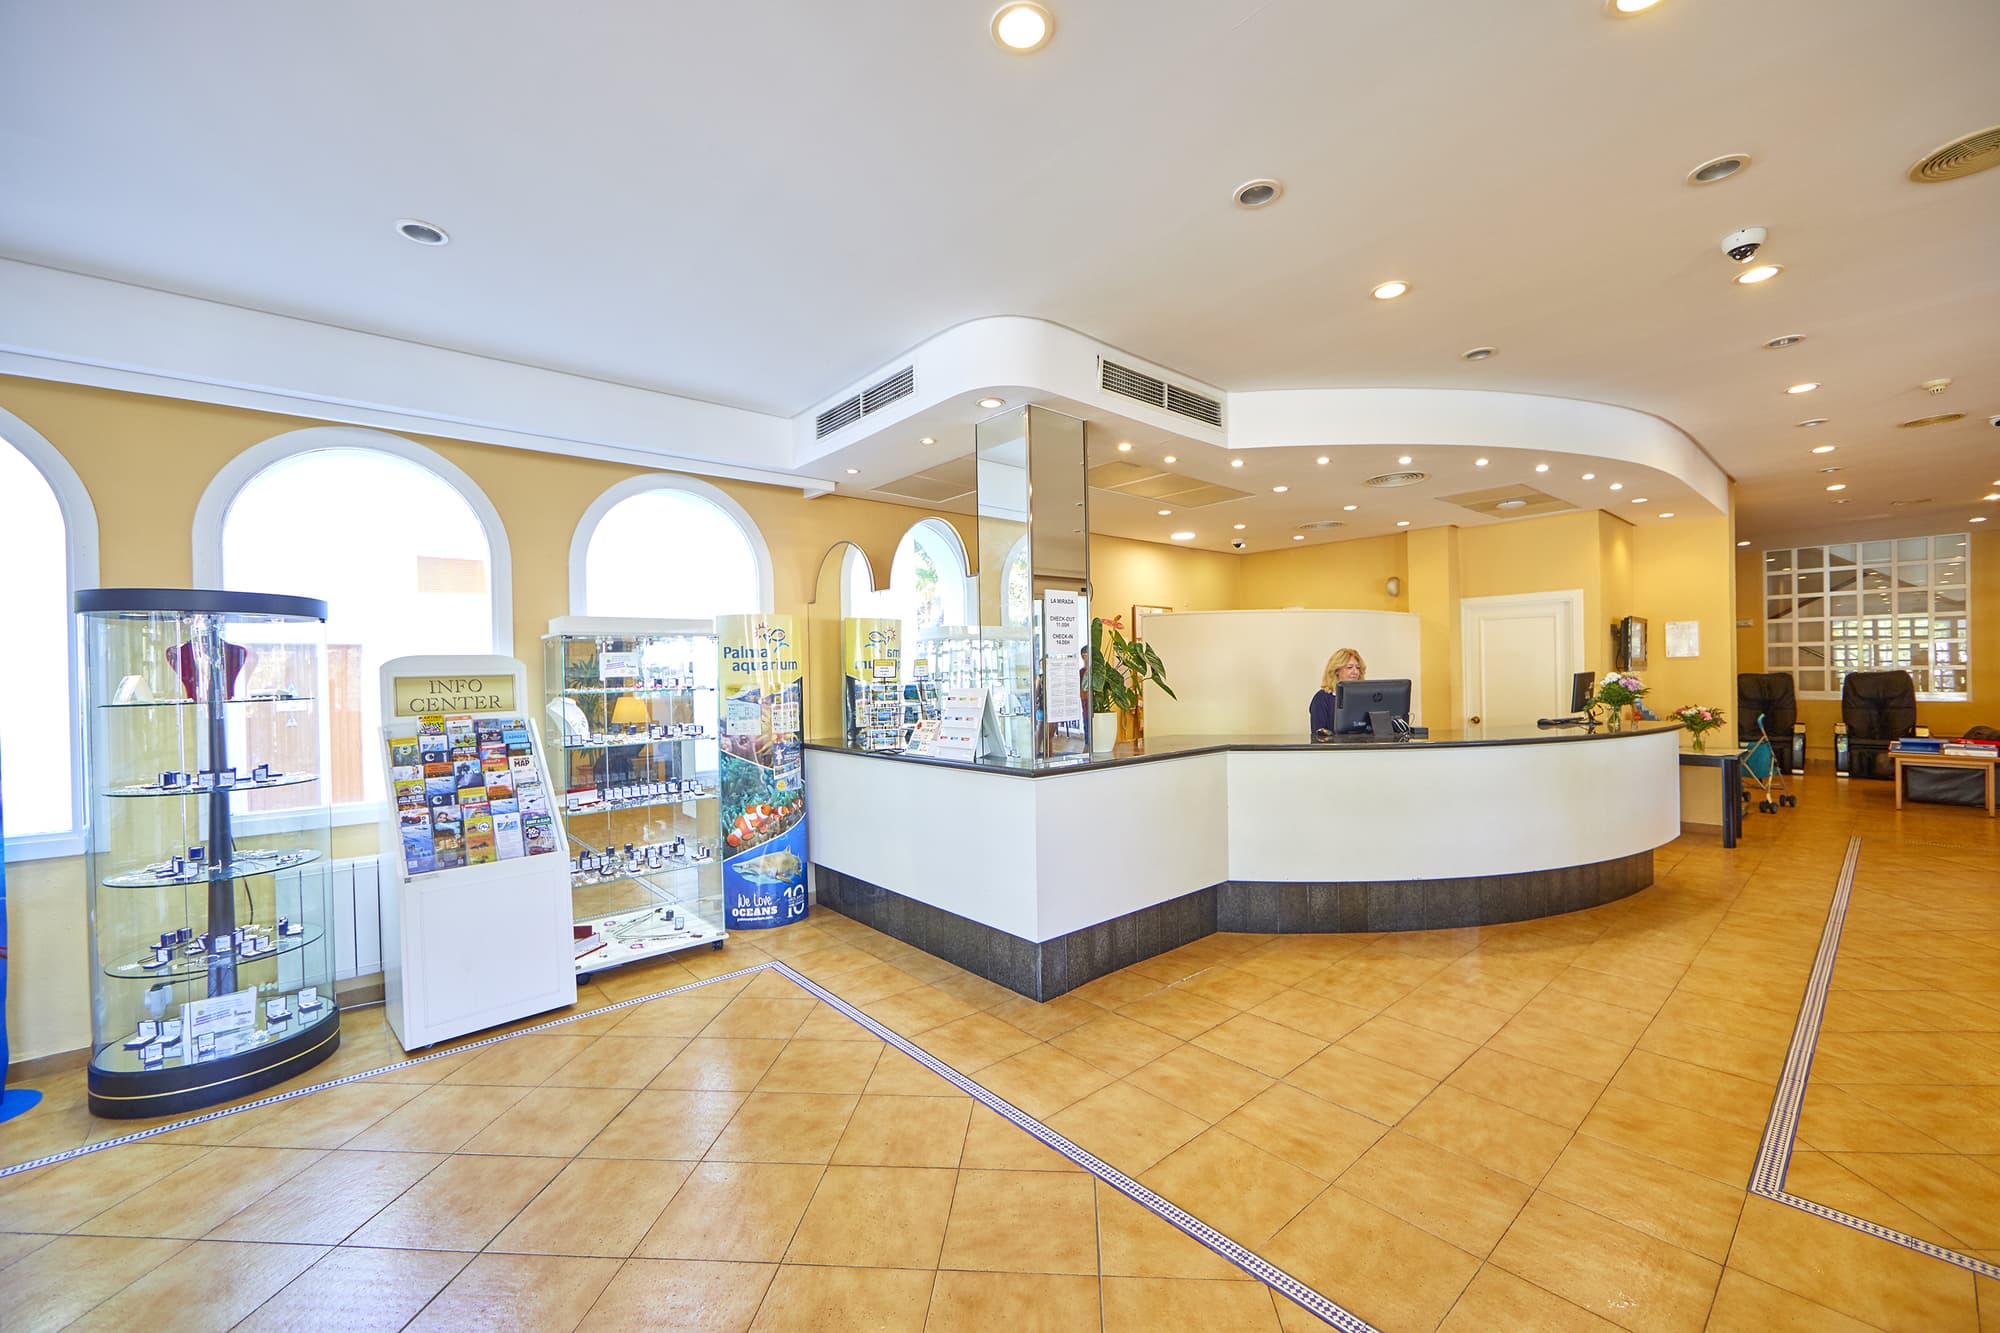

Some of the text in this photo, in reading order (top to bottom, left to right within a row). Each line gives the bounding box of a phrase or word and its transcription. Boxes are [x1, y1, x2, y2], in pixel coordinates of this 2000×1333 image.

[723, 645, 768, 659] Palma
[732, 660, 798, 675] aquarium
[428, 678, 483, 694] INFO
[409, 695, 502, 713] CENTER
[514, 759, 530, 768] MAP
[737, 893, 751, 908] We
[731, 905, 778, 917] OCEANS
